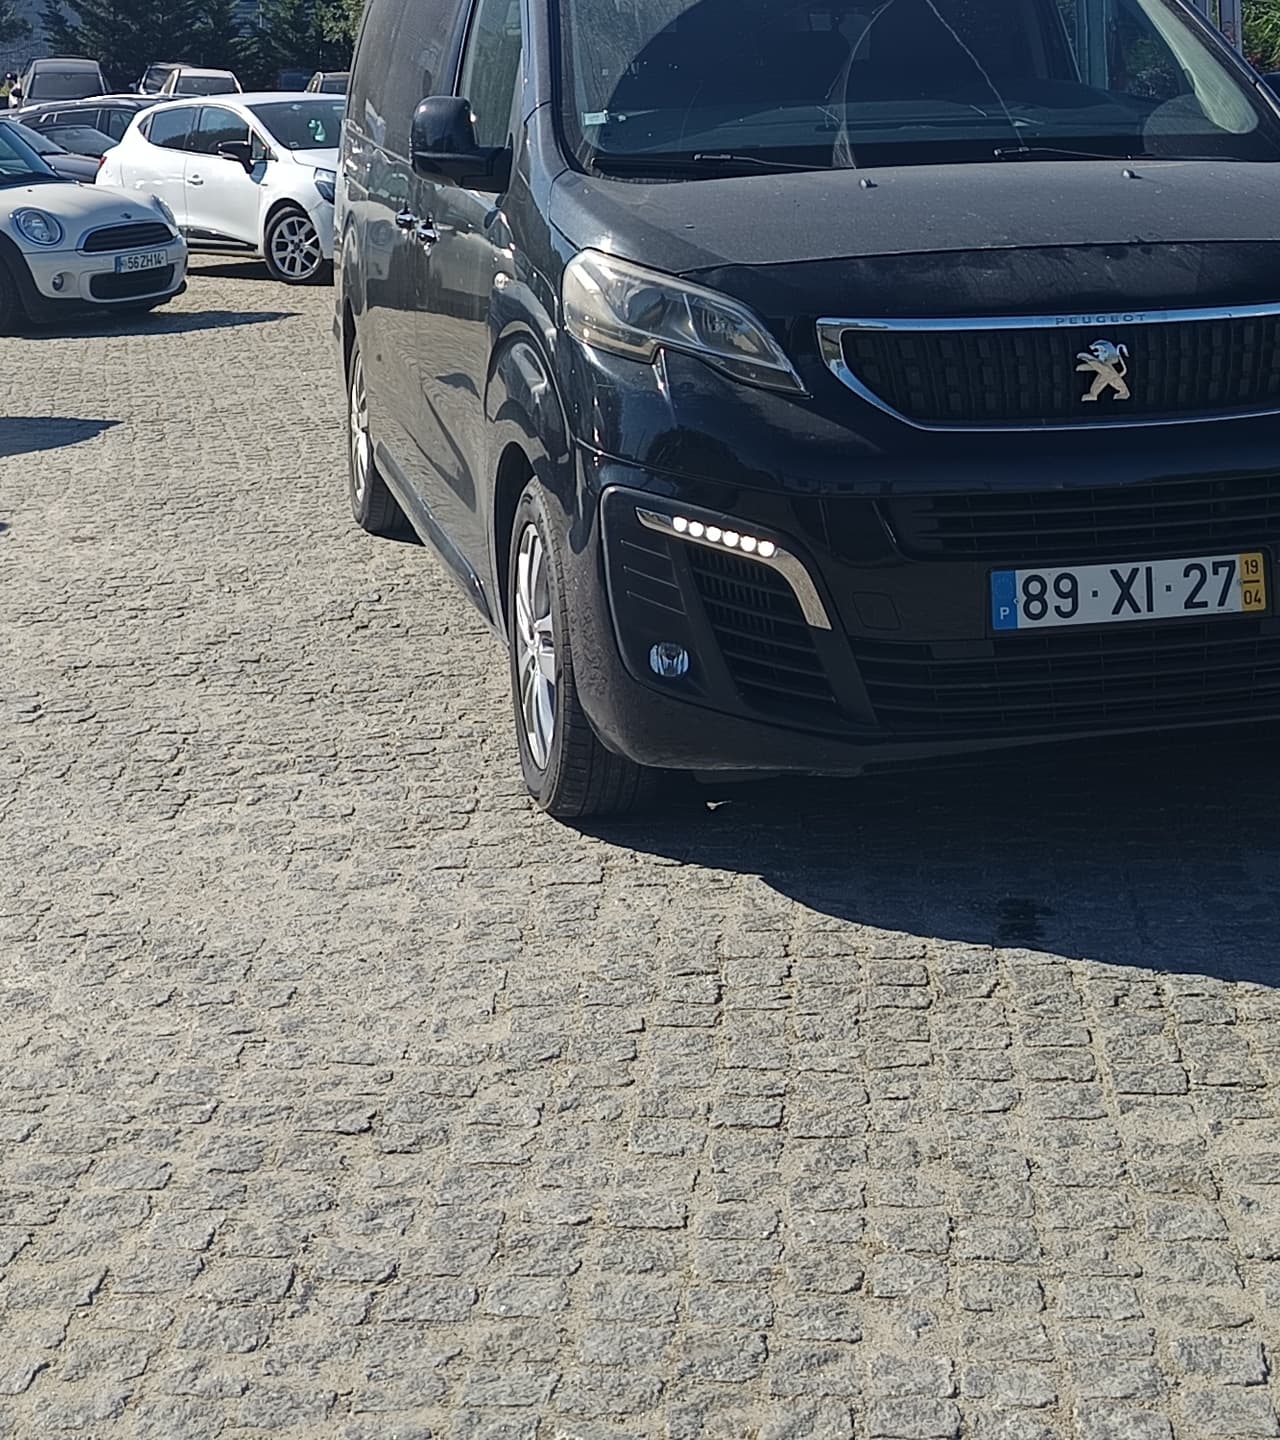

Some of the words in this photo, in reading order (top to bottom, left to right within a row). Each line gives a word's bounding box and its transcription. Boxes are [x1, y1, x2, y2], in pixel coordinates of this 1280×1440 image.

[1055, 313, 1147, 326] PEUGEOT
[1244, 559, 1259, 575] 19
[1243, 590, 1262, 606] 04
[999, 606, 1010, 620] P
